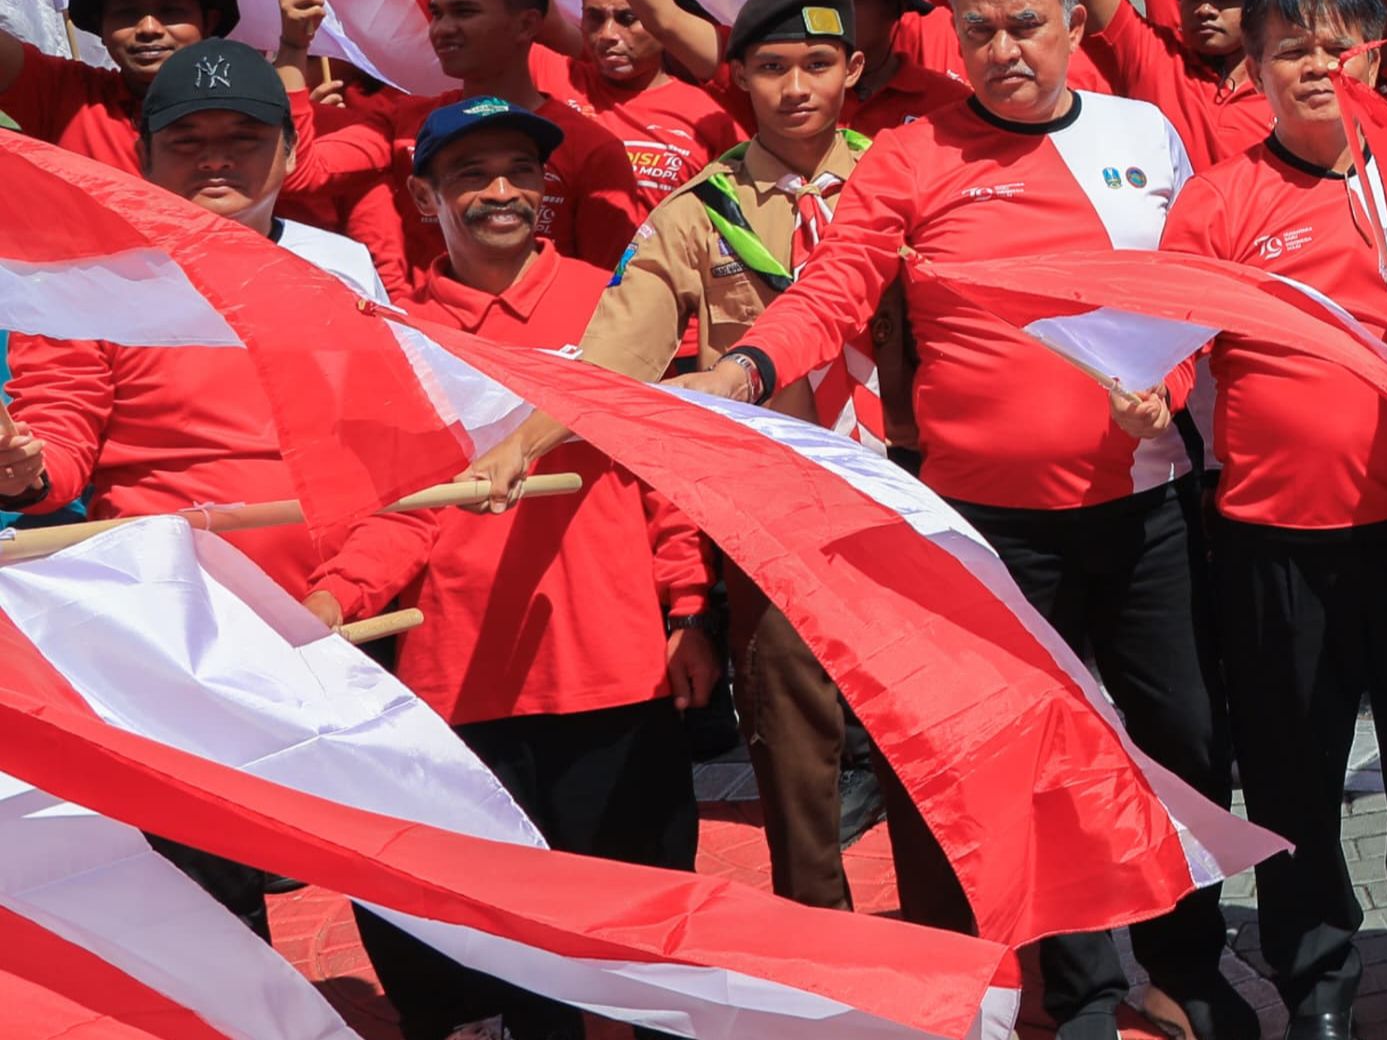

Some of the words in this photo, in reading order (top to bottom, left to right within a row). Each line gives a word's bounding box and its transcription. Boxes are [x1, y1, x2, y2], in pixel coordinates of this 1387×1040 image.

[662, 151, 683, 171] 79
[639, 165, 679, 181] MDPL
[1254, 235, 1282, 259] 79
